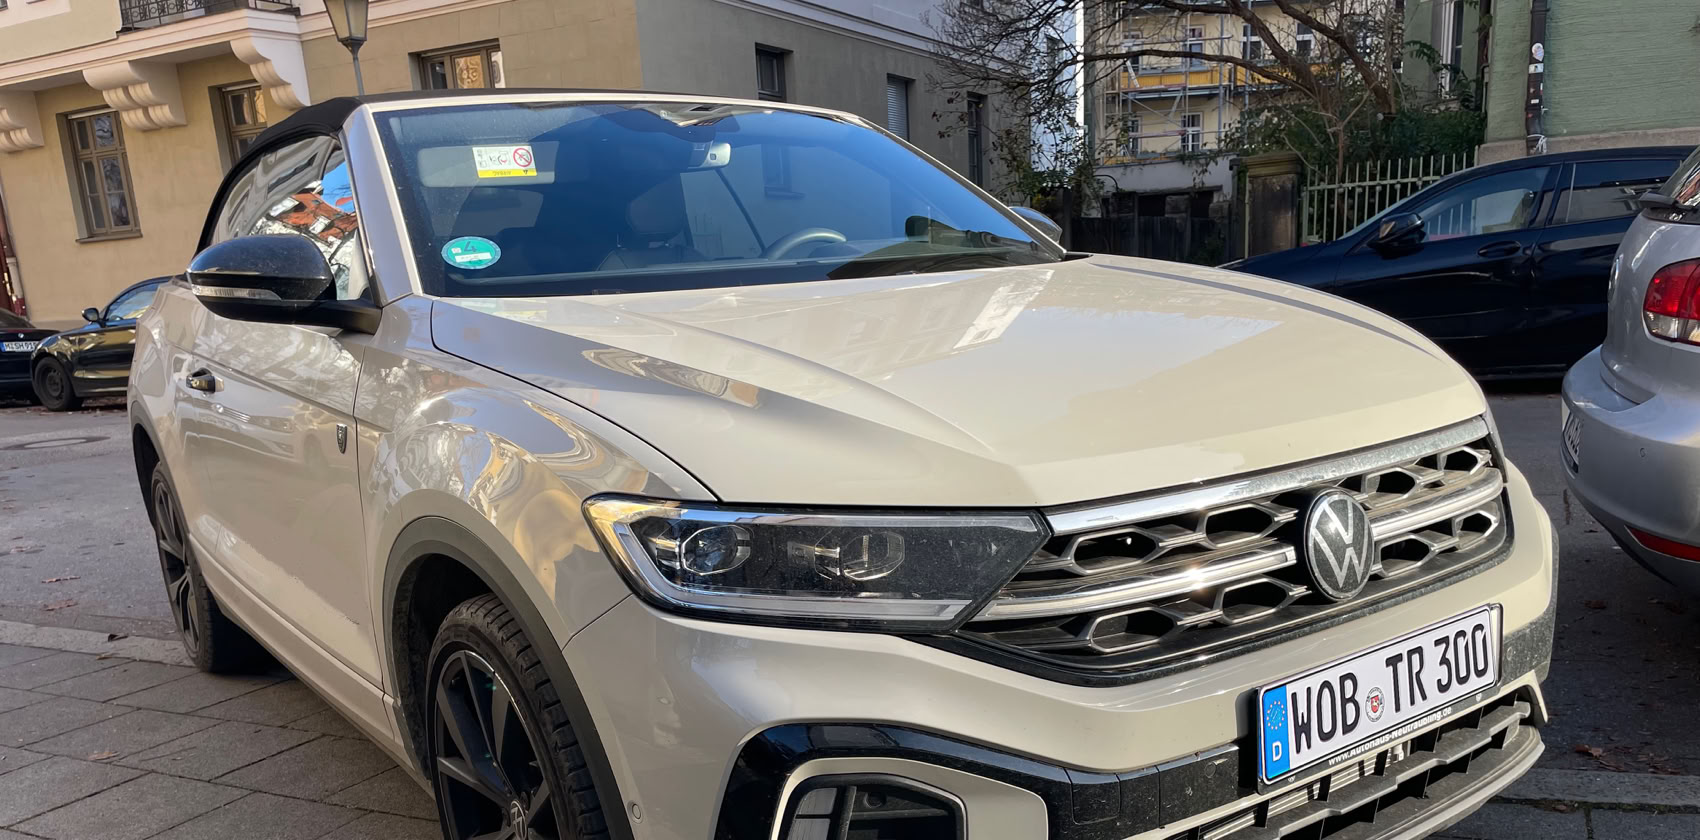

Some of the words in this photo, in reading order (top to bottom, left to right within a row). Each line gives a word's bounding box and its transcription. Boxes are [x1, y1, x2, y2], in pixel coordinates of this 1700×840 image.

[464, 241, 477, 252] 4
[1291, 672, 1360, 755] WOB
[1385, 645, 1428, 714] TR
[1434, 623, 1489, 694] 300
[1272, 740, 1282, 762] D
[1328, 706, 1453, 766] www.Autohaus-Neutraubling.de
